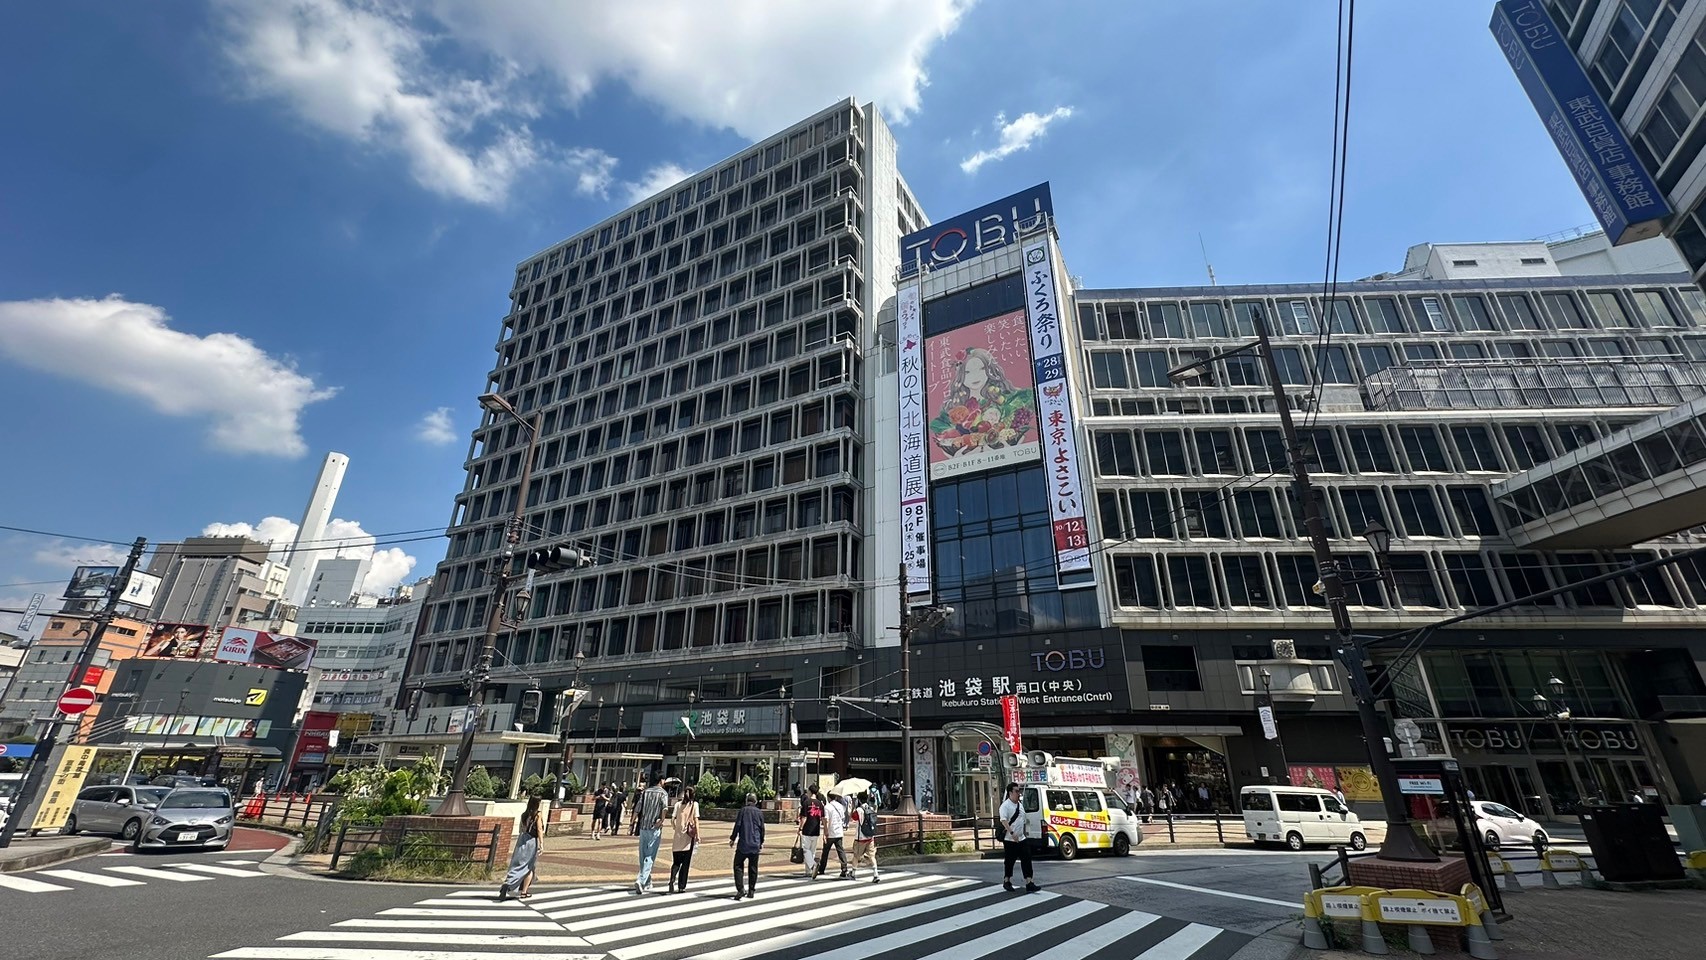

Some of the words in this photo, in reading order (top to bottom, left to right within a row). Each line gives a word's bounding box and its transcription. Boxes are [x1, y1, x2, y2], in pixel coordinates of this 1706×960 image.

[1512, 1, 1557, 49] TOBU
[1497, 17, 1525, 70] TOBU
[1566, 94, 1626, 165] 東武百貨店
[1606, 162, 1655, 210] 事務館
[1549, 111, 1592, 185] 東武百貨店
[1586, 176, 1618, 229] 事務館
[907, 197, 1044, 270] TOBU
[1030, 270, 1056, 350] ふくろ祭り
[1045, 368, 1059, 381] 29
[900, 355, 924, 498] 秋の大北海道展
[1013, 447, 1037, 458] TOBU
[1048, 410, 1077, 514] 東京よさこい
[915, 532, 926, 569] 催事場
[1067, 533, 1082, 548] 13
[222, 645, 247, 655] KIRIN
[1031, 648, 1105, 672] TOBU
[939, 676, 1010, 698] 池袋駅
[942, 698, 979, 708] Ikebukuro
[1019, 696, 1040, 705] West
[1043, 692, 1113, 704] Entrance(Cntrl)
[465, 710, 475, 730] P
[700, 709, 745, 726] 池袋駅
[725, 726, 745, 734] Station
[1449, 729, 1522, 749] TOBU
[1564, 729, 1638, 750] TOBU
[1012, 770, 1047, 782] 日本共産党
